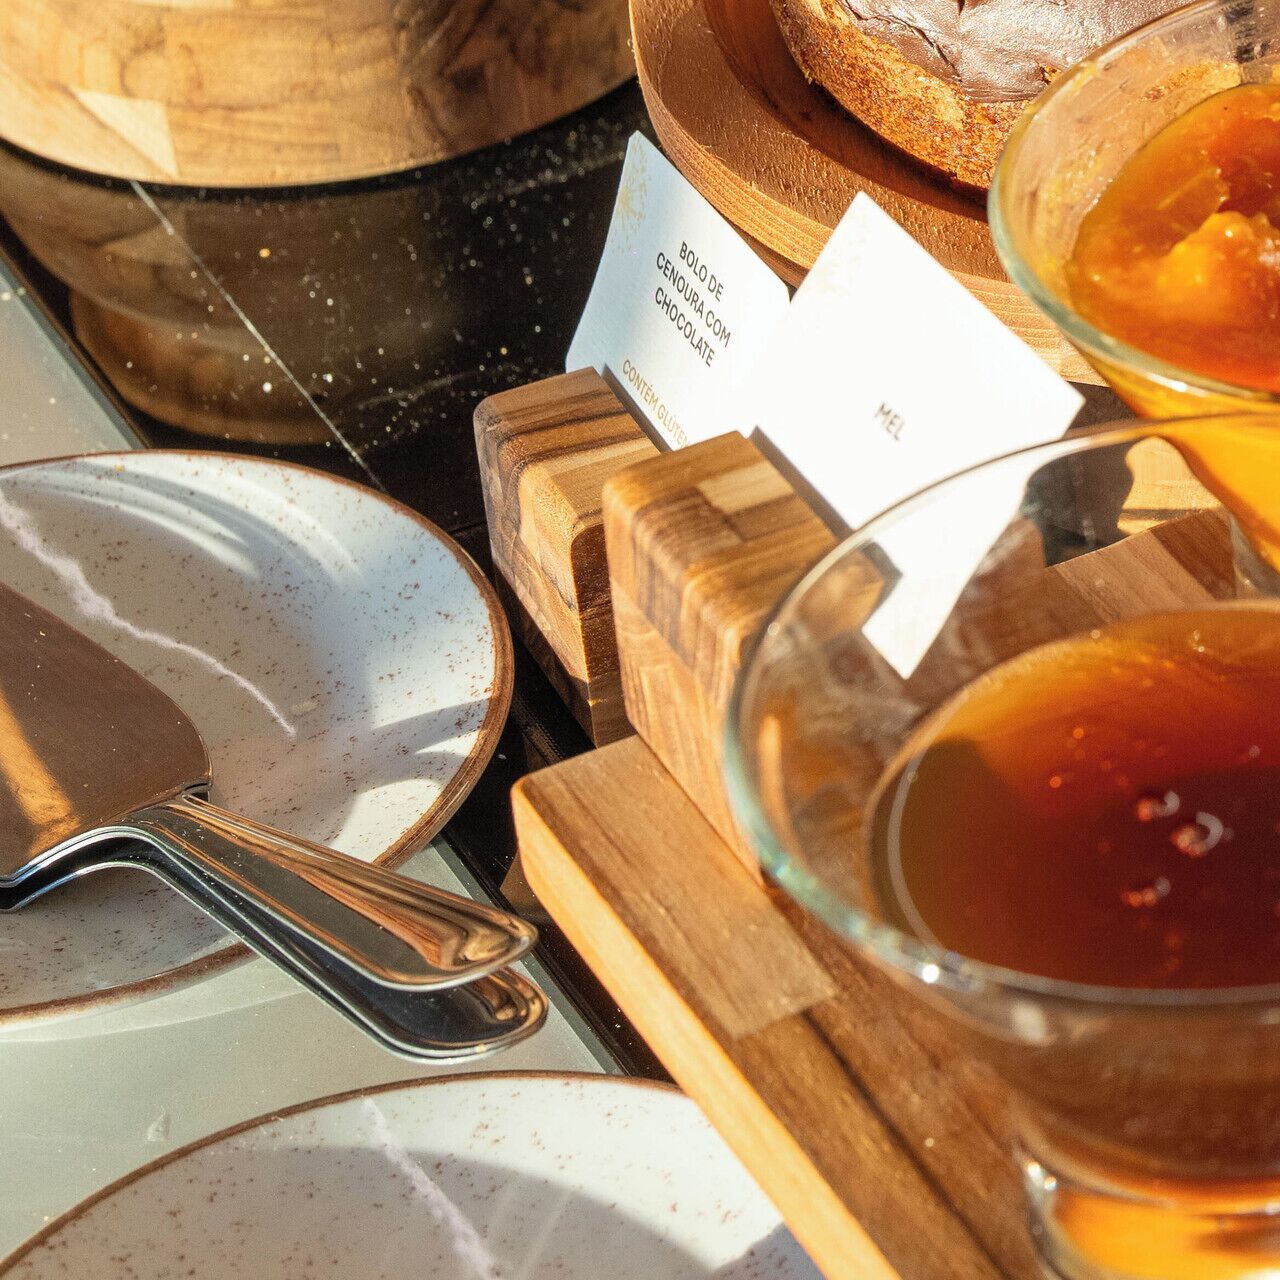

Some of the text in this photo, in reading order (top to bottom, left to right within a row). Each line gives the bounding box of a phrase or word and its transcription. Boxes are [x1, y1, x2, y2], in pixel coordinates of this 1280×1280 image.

[655, 251, 732, 348] CENOURA COM
[679, 240, 725, 303] BOLO DE
[654, 286, 716, 368] CHOCOLATE
[622, 359, 660, 411] CONTÉM
[874, 401, 906, 441] MEL
